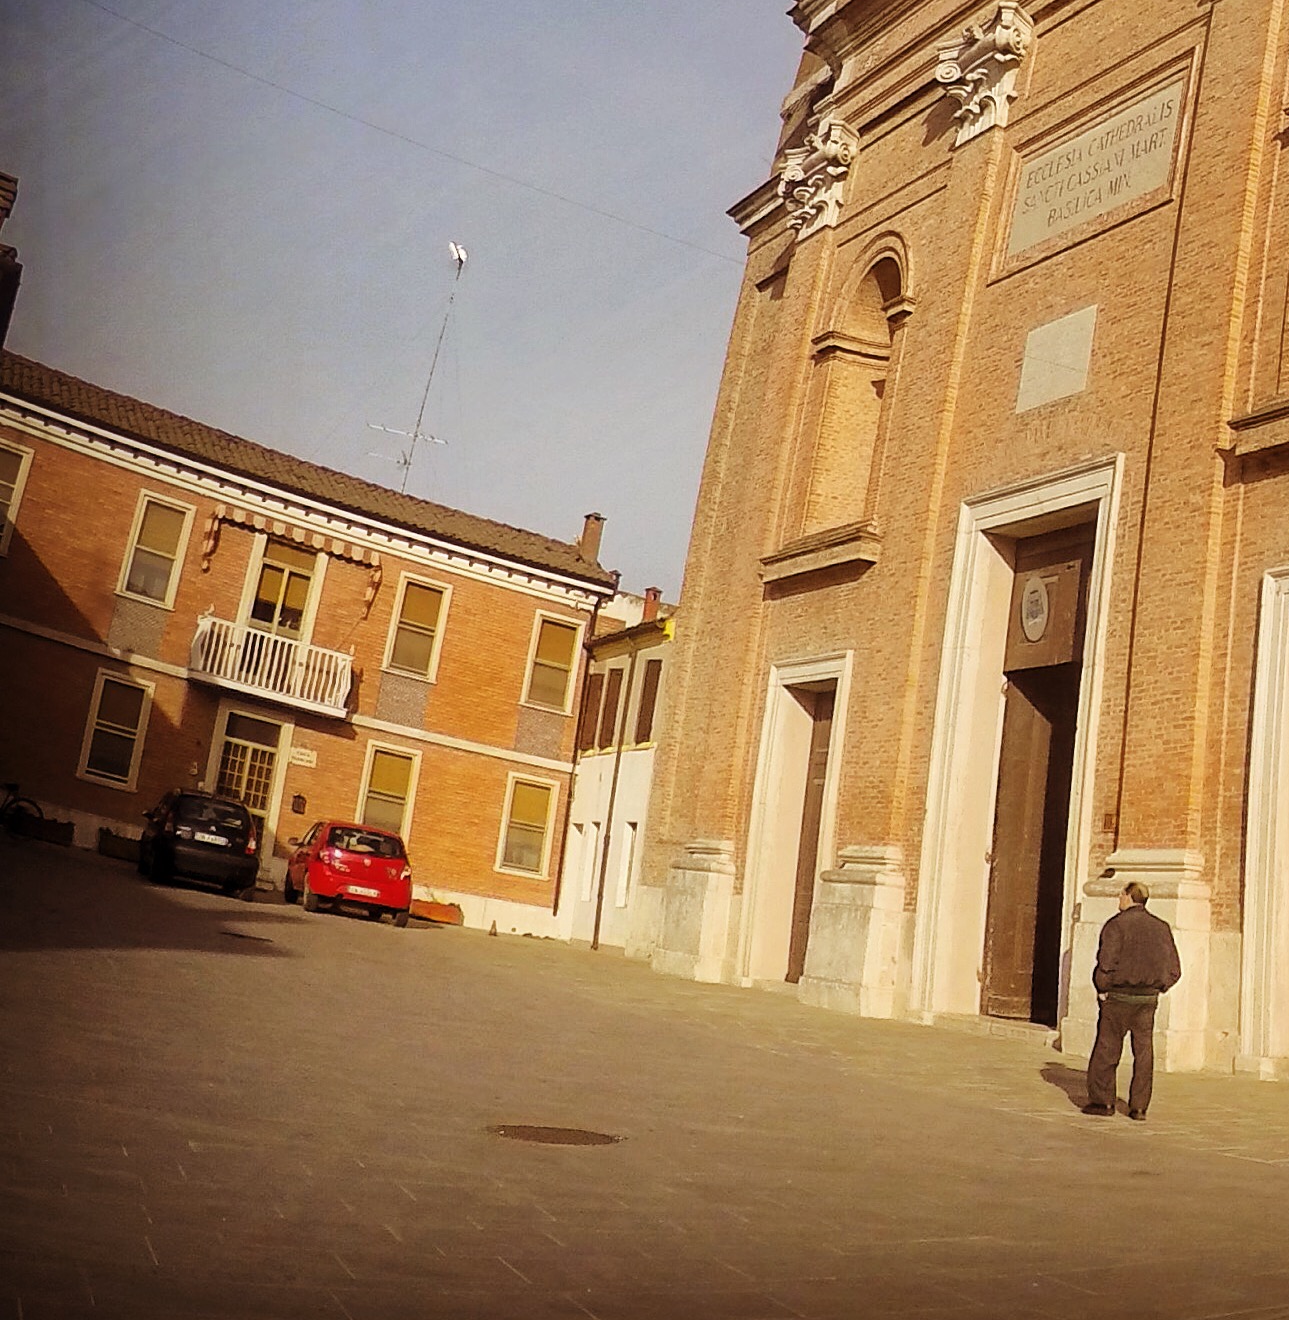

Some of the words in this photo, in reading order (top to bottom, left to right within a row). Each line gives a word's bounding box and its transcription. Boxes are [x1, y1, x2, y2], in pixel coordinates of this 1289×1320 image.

[1026, 147, 1083, 190] ECCLESIA
[1087, 99, 1174, 157] CATHEDRALIS
[1047, 186, 1103, 227] BASILICA
